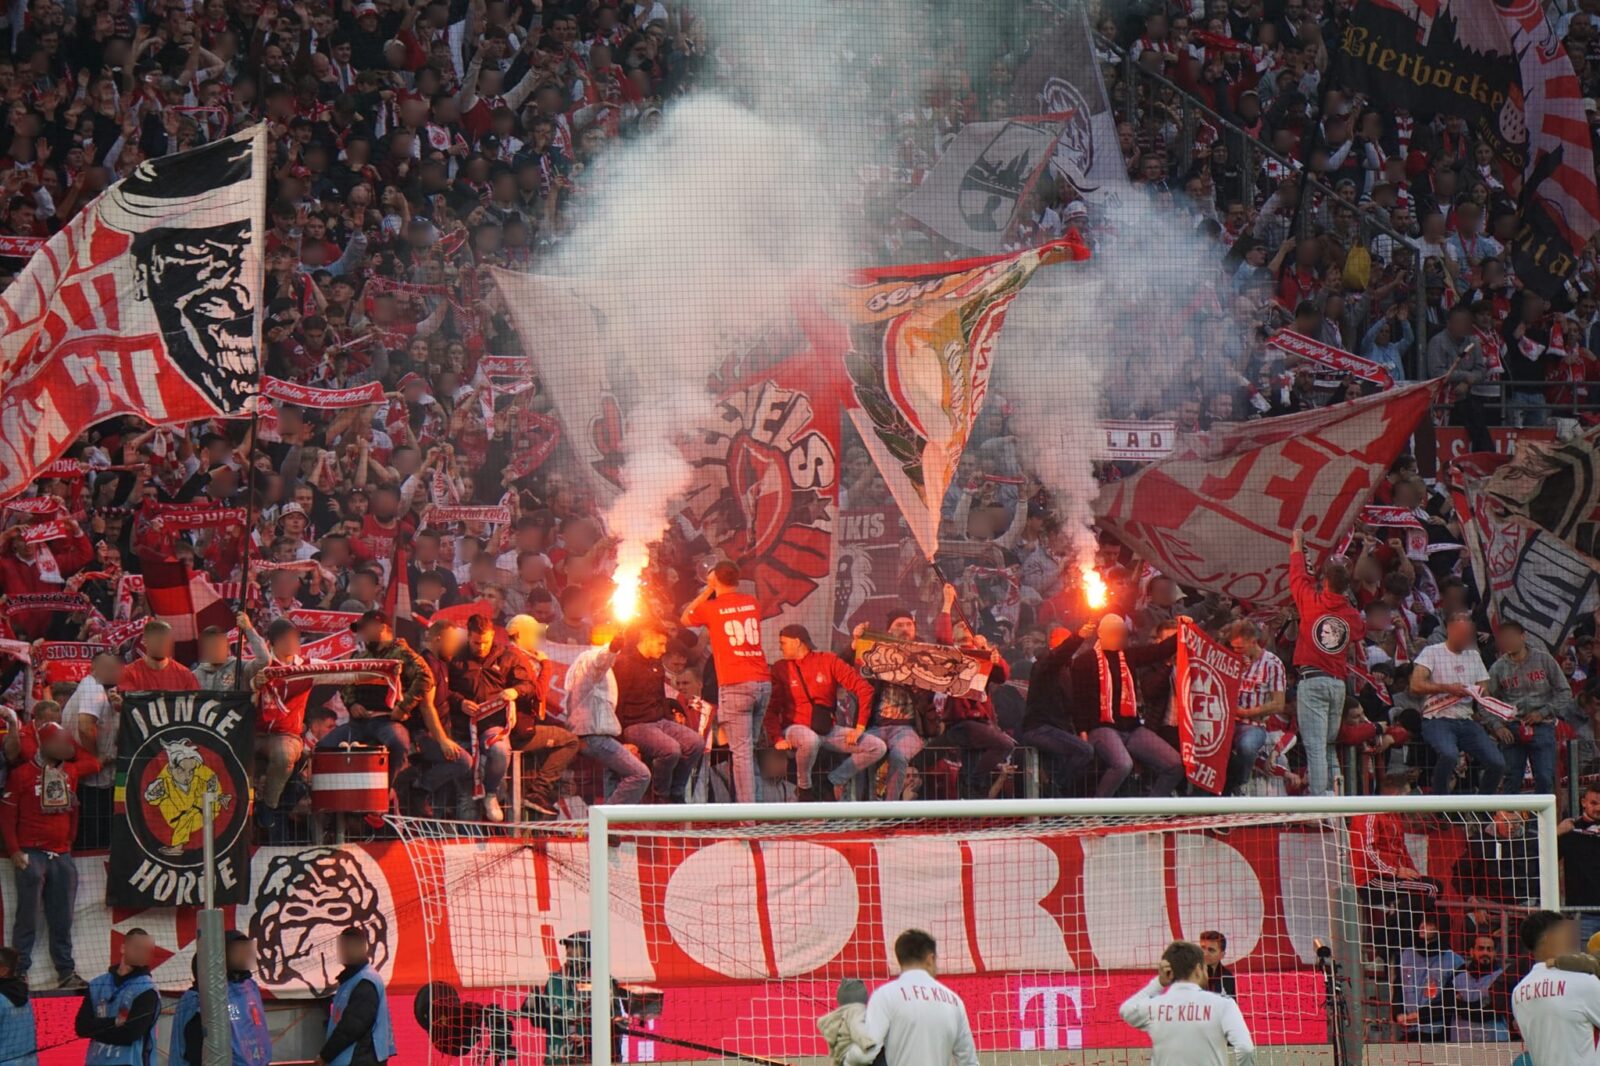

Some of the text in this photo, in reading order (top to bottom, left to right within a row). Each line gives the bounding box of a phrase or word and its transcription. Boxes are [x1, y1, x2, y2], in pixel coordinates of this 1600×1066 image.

[724, 617, 760, 647] 96
[47, 645, 78, 660] SIND
[1180, 624, 1242, 681] DEIN WILLE
[131, 695, 242, 740] JUNGE
[129, 856, 238, 905] HORE
[901, 985, 959, 1008] 1. FC KÖLN
[1520, 980, 1566, 1002] FC KÖLN
[1158, 1004, 1174, 1022] FC
[1177, 1002, 1212, 1022] KÖLN
